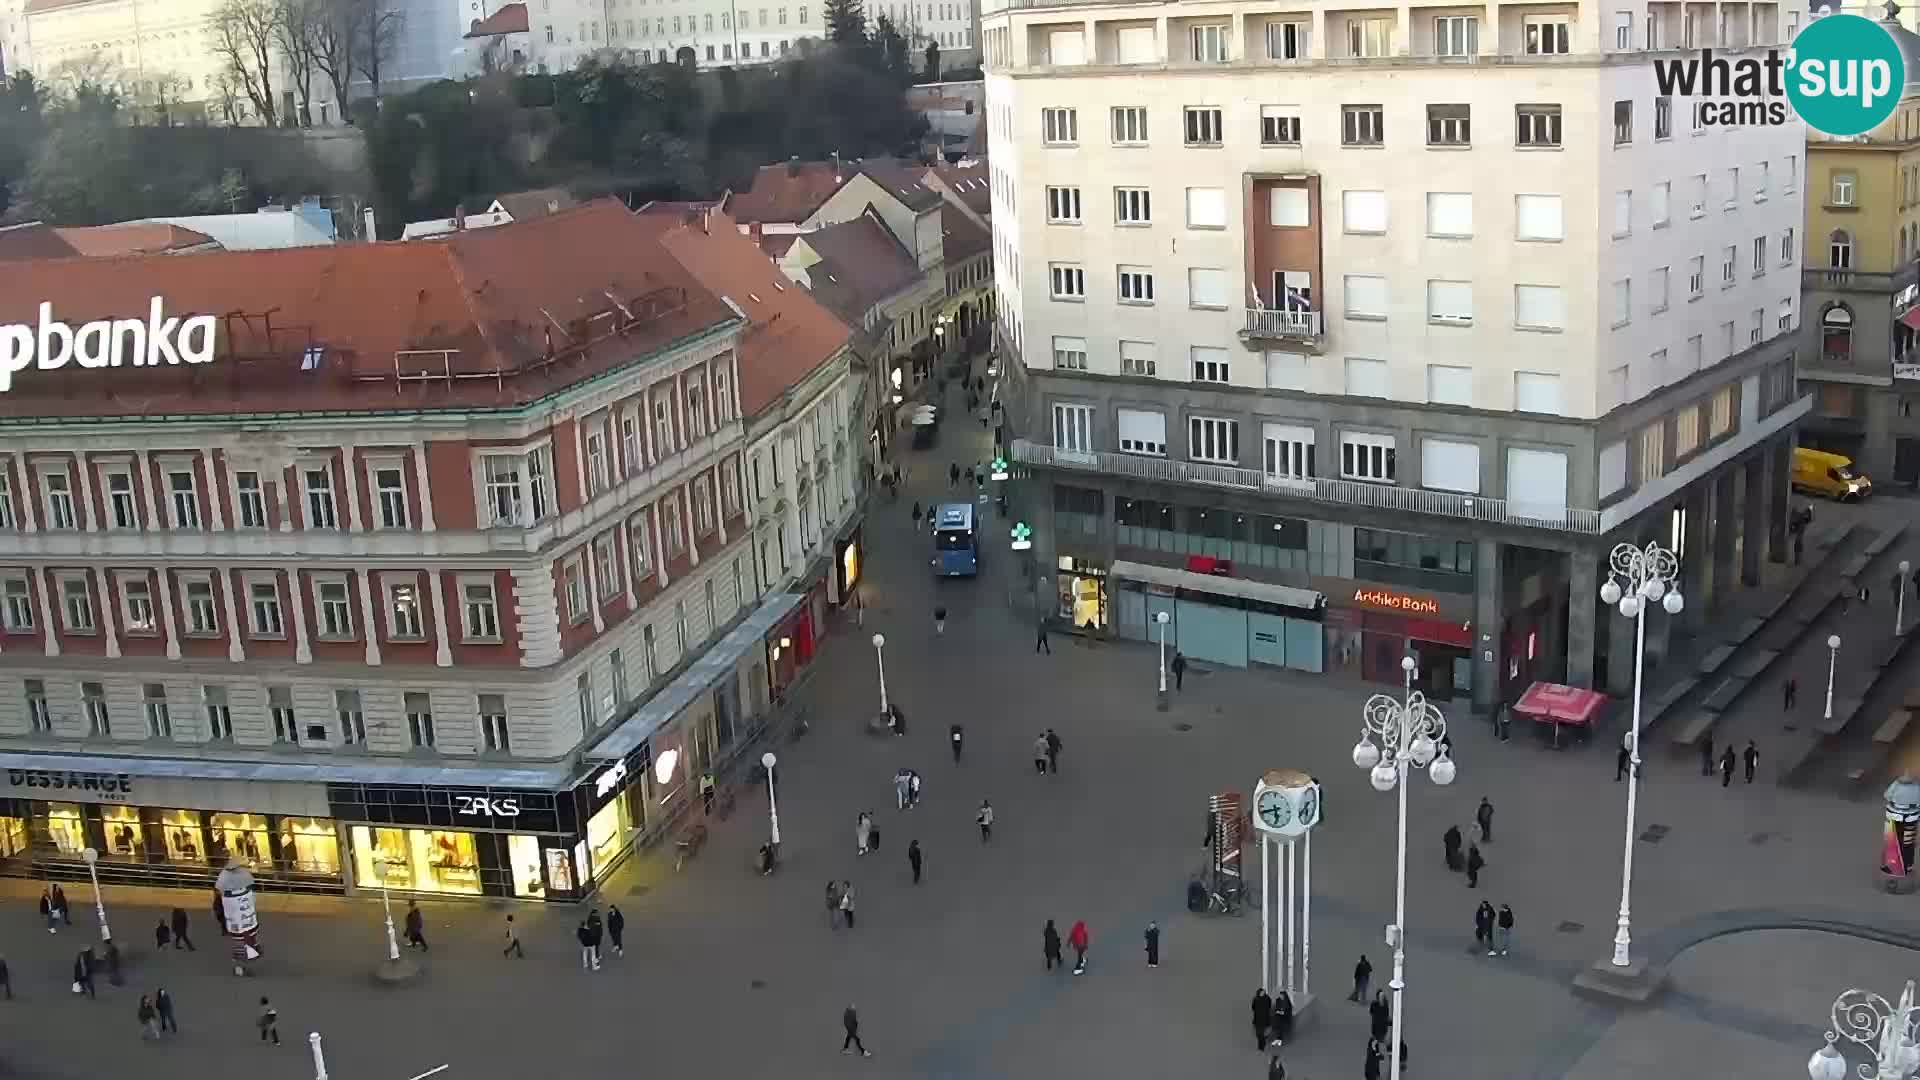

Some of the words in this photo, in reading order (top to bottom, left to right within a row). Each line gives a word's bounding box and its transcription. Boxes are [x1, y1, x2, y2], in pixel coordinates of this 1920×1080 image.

[0, 296, 216, 392] pbanka
[1354, 589, 1401, 608] Addiko
[1402, 597, 1437, 613] Bank
[8, 768, 132, 792] DESSANGE
[456, 796, 520, 816] ZAKS
